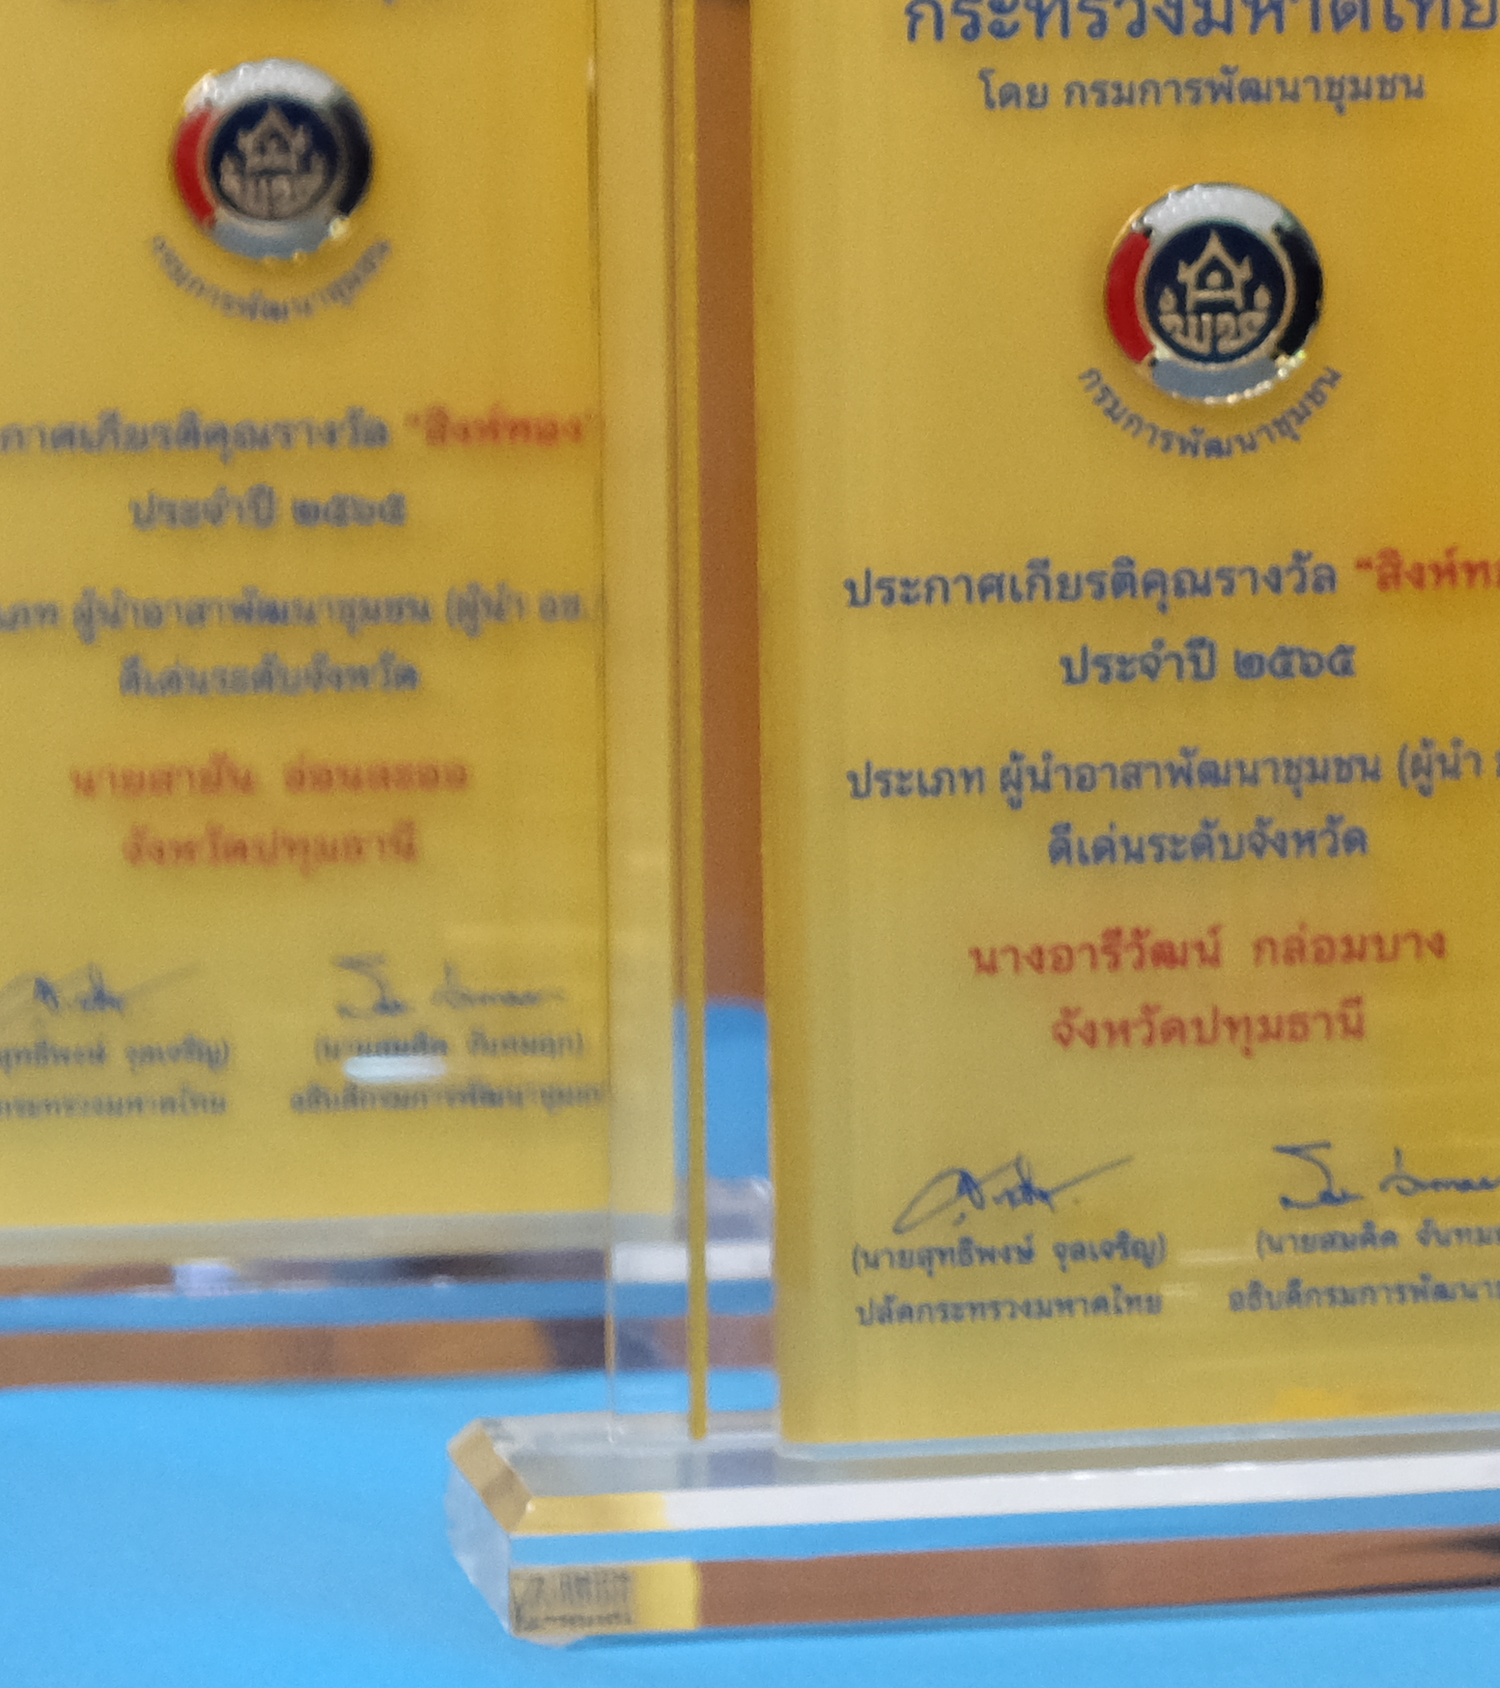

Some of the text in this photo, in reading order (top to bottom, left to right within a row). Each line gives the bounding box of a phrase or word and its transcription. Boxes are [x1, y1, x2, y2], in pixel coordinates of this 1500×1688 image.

[977, 63, 1428, 118] โดย กรมการพัฒนาชุมชน
[1077, 363, 1344, 461] กรมการพัฒนาชุมชน
[842, 548, 1340, 617] ประกาศเกียรติคุณรางวัล
[1058, 634, 1358, 688] ประจำปี ๒๕๖๕
[845, 758, 987, 802] ประเภท
[1000, 744, 1384, 813] ผู้นำอาสาพัฒนาชุมชน
[1397, 734, 1485, 800] (ผู้นำ
[1046, 812, 1371, 868] ดีเด่นระดับจังหวัด
[968, 922, 1448, 977] นางอารีวัฒน์ กล่อมบาง
[1051, 994, 1367, 1059] จังหวัดปทุมธานี
